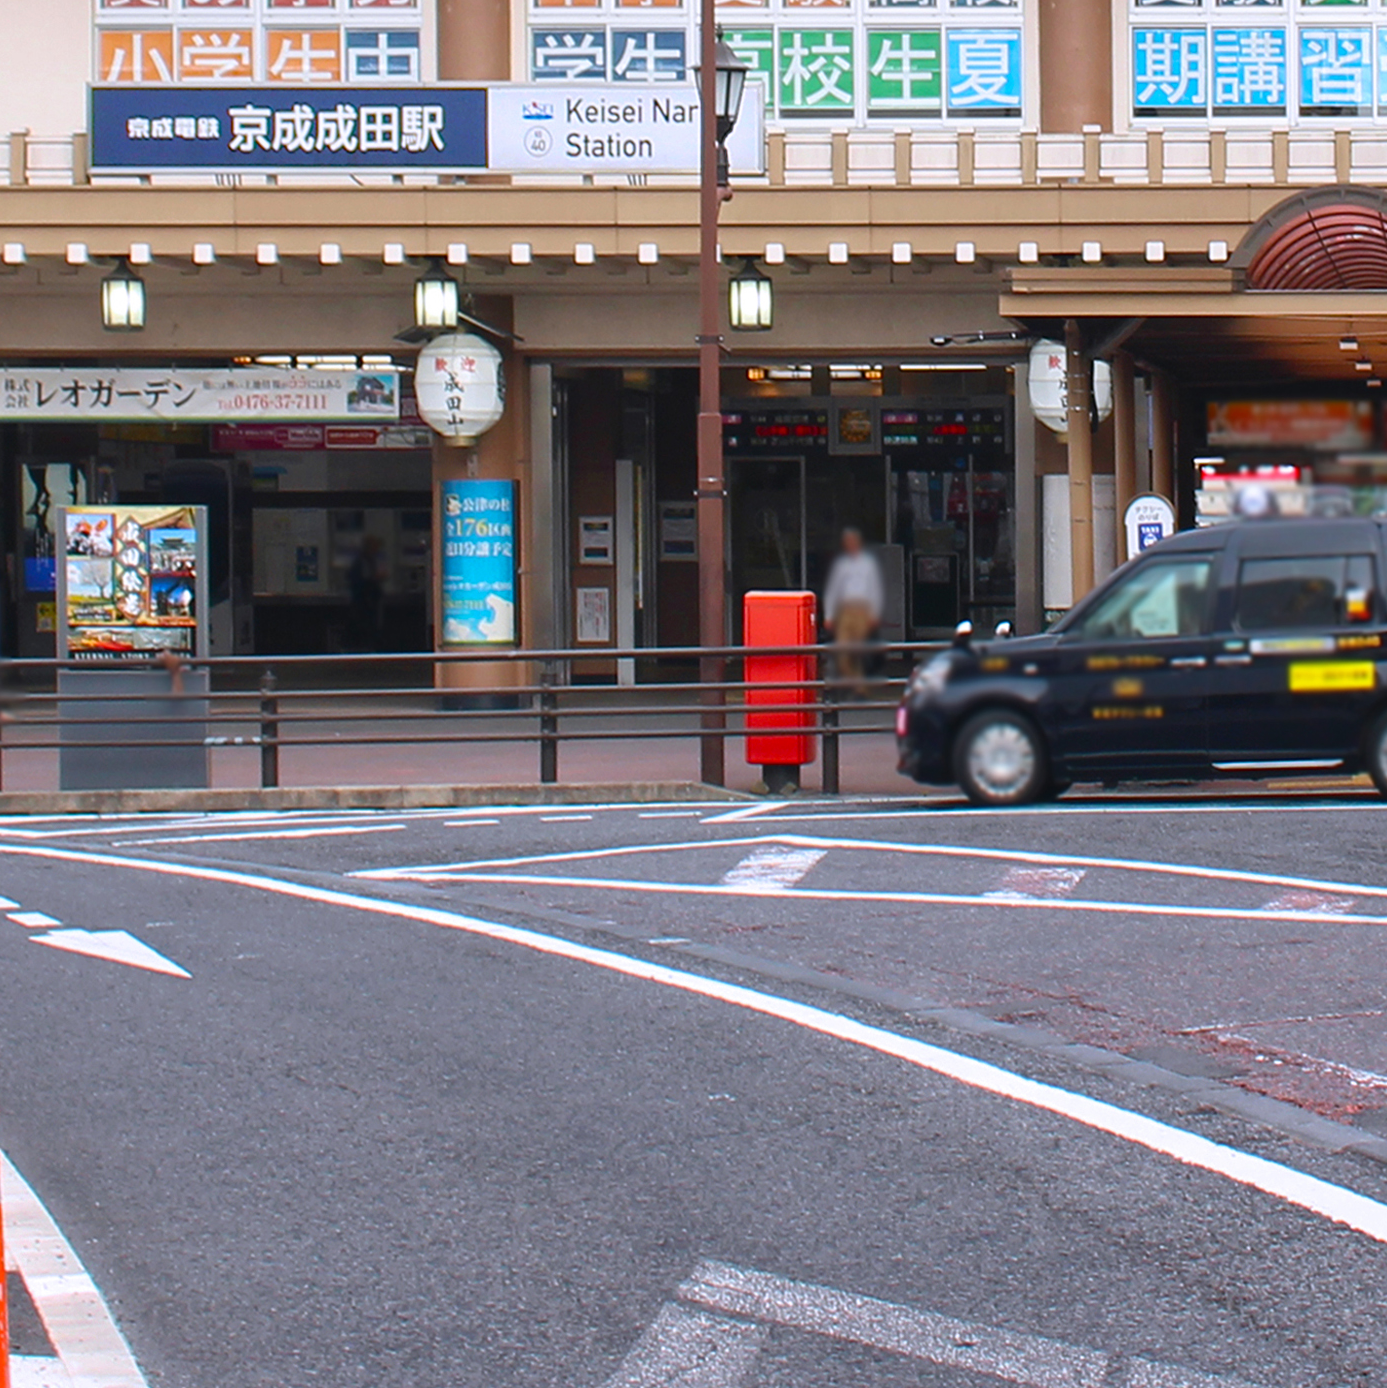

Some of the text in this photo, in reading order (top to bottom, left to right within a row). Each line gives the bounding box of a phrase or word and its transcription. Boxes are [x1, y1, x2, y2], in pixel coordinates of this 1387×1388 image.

[105, 32, 419, 83] 小学生中
[565, 98, 700, 124] Keisei Nar
[126, 103, 446, 153] 京成電鉄 京成成田駅
[530, 139, 547, 152] 40
[565, 132, 653, 158] Station
[4, 395, 31, 409] 会社
[35, 378, 197, 409] レオガーデン
[234, 393, 328, 410] 0476-37-7111
[443, 371, 464, 426] 成田山
